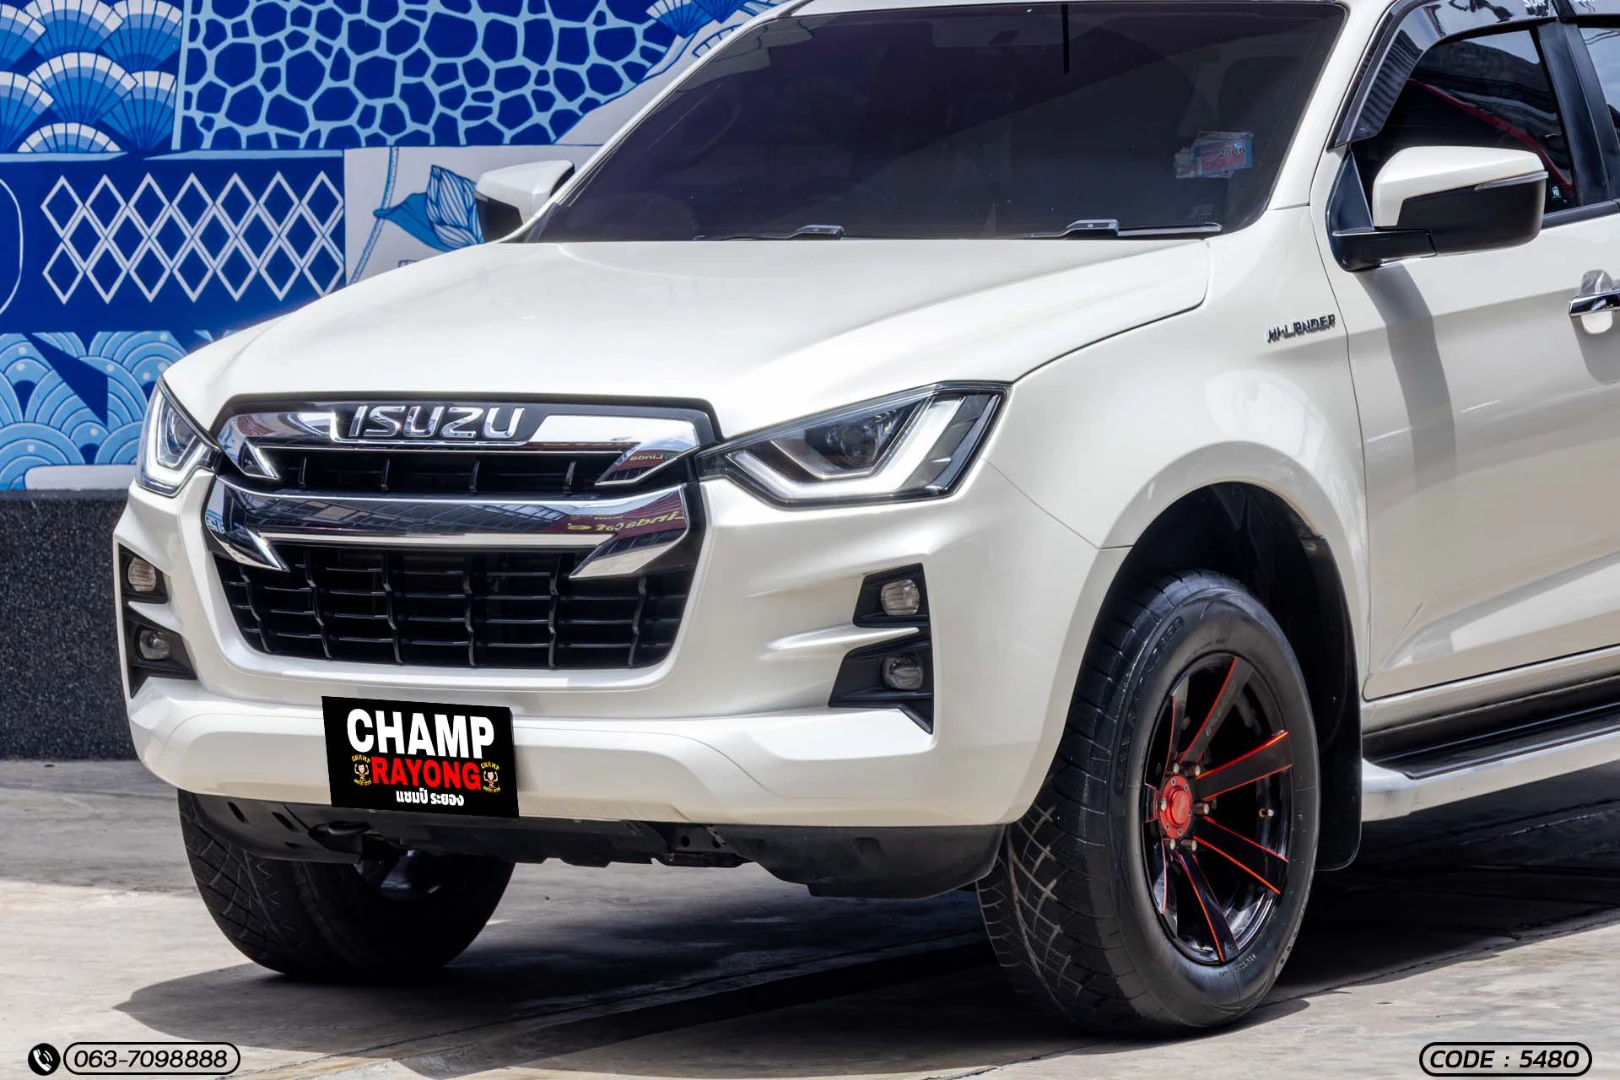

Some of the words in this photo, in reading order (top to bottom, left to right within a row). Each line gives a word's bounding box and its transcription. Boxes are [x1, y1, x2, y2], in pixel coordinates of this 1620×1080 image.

[349, 405, 525, 438] ISUZU
[346, 708, 495, 759] CHAMP
[371, 756, 481, 791] RAYONG
[430, 792, 465, 807] ระยอง
